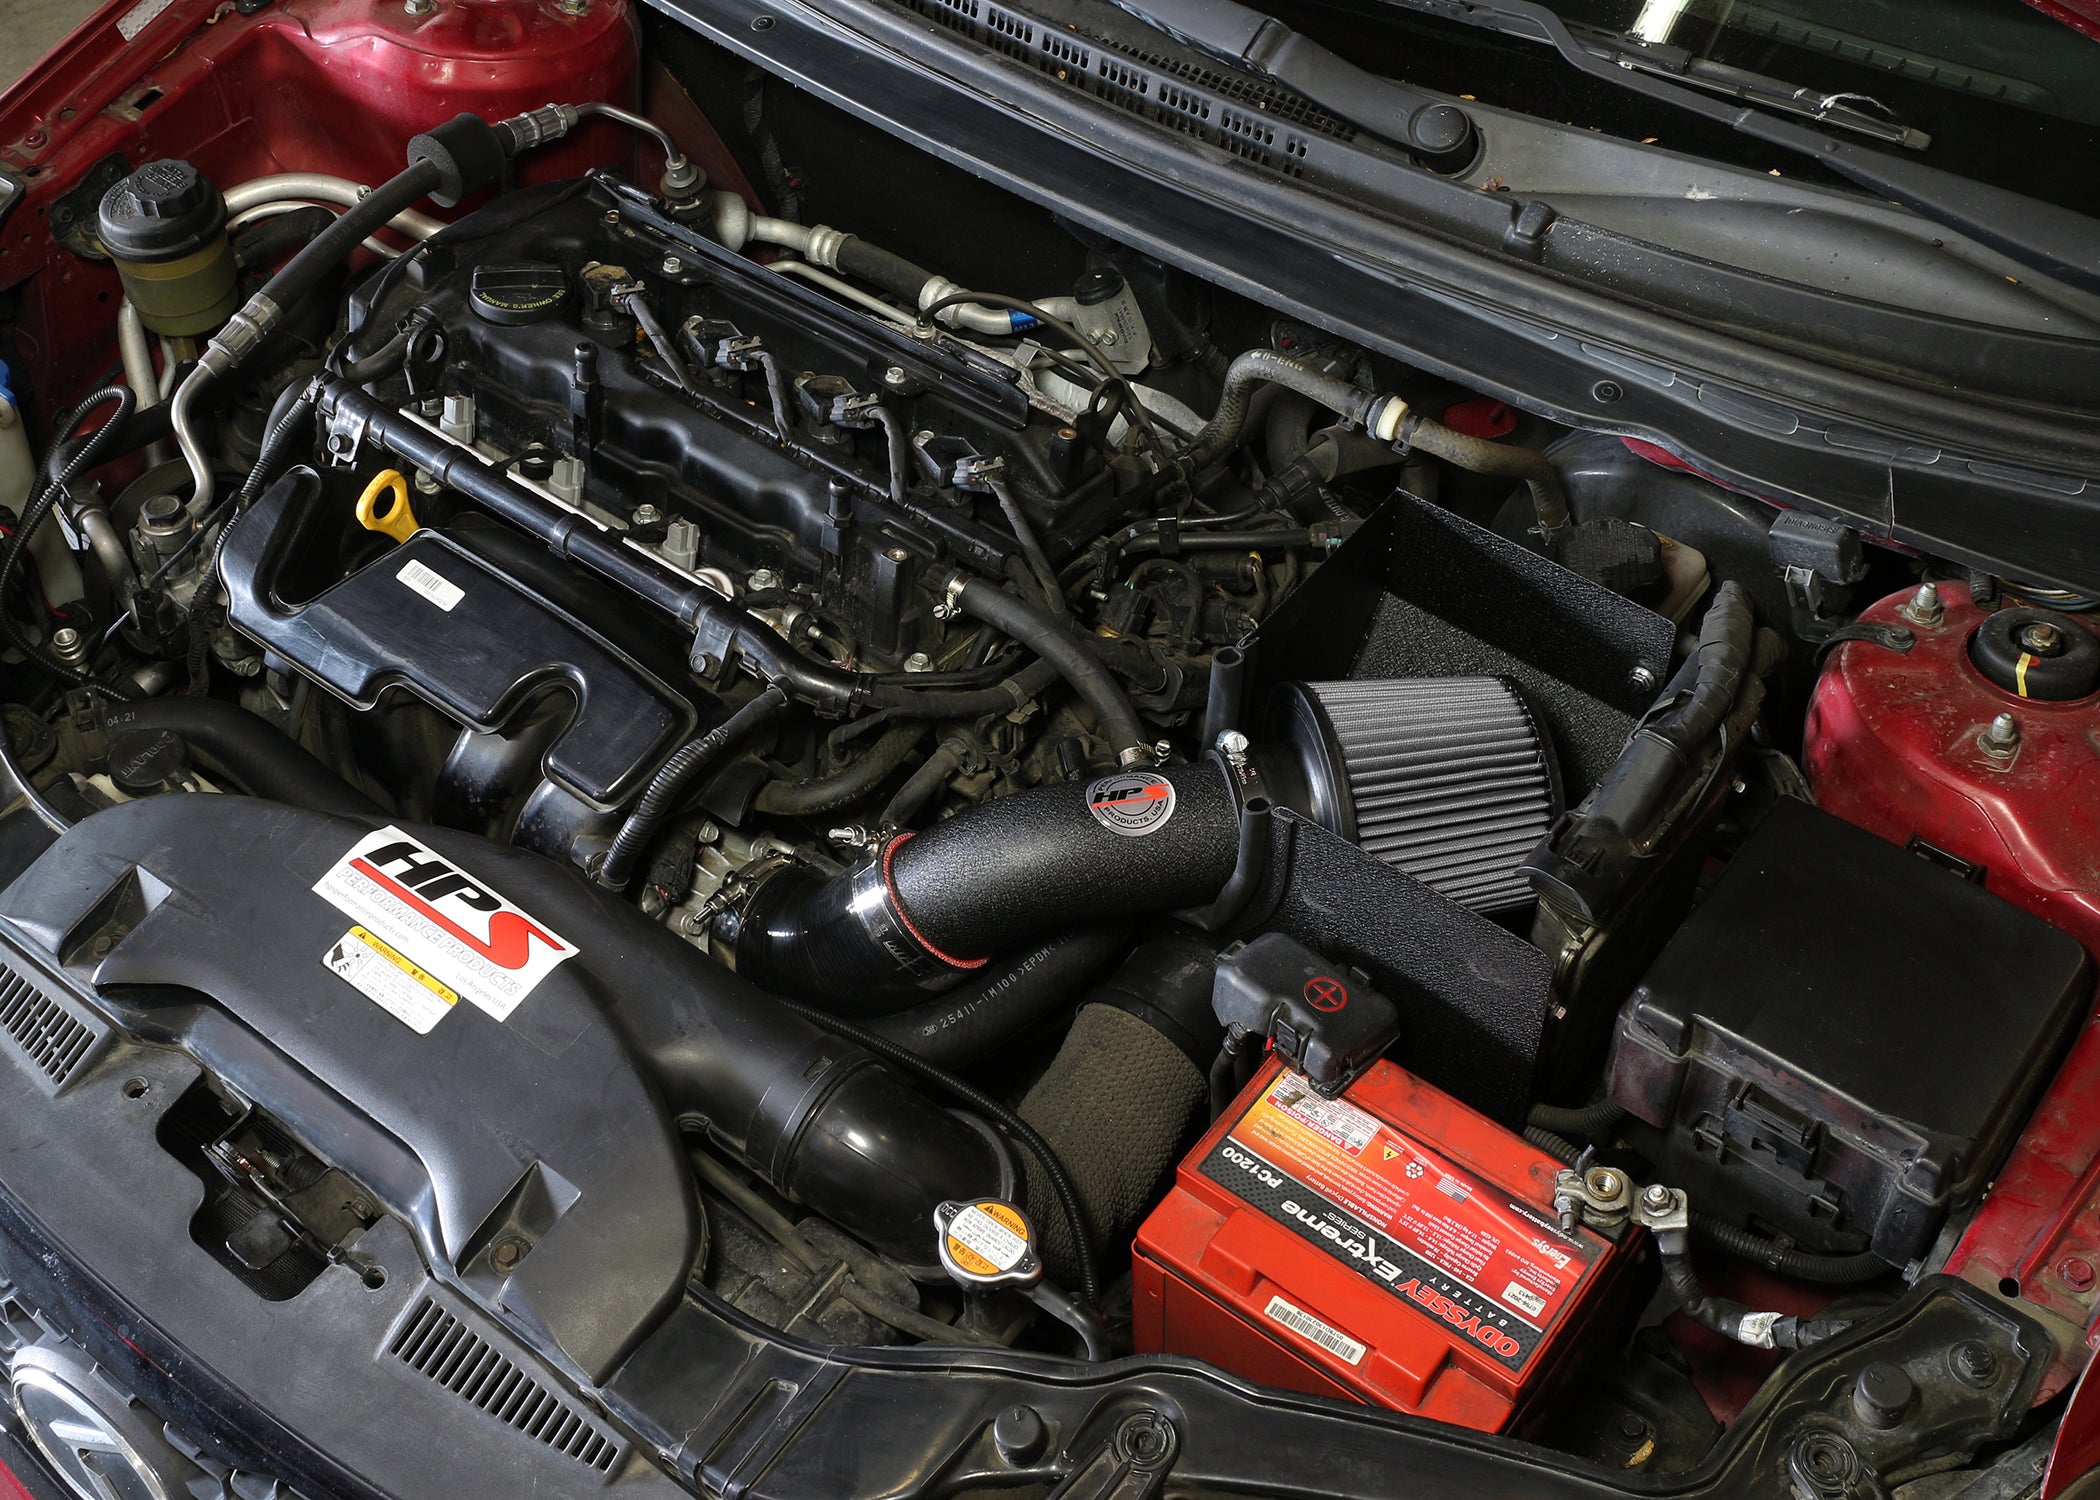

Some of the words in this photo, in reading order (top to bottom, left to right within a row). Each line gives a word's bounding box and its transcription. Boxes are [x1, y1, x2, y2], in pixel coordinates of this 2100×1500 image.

[479, 291, 509, 307] MANUAL
[1784, 515, 1837, 532] DIAGNOSIS
[120, 733, 177, 778] COOLANT
[1092, 783, 1168, 803] HPS
[1098, 775, 1158, 790] PERFORMANCE
[1151, 800, 1163, 816] USA
[322, 880, 410, 944] hpsperformanceproducts.com
[364, 840, 565, 965] HPS
[335, 865, 447, 946] PERFORMANCE
[438, 936, 523, 997] PRODUCTS
[371, 941, 402, 964] WARNING
[455, 972, 468, 984] Los
[489, 996, 506, 1010] USA
[1273, 1100, 1342, 1144] DANGER/POISON
[1218, 1144, 1284, 1190] PC1200
[1304, 1173, 1327, 1189] Battery
[1323, 1185, 1345, 1201] Drycell
[992, 1210, 1025, 1235] WARNING
[1341, 1198, 1388, 1228] NONSPILLABLE
[1279, 1199, 1403, 1282] Extreme
[1535, 1272, 1559, 1287] roducts
[1427, 1274, 1509, 1328] BATTERY
[1394, 1272, 1523, 1361] ODYSSEY
